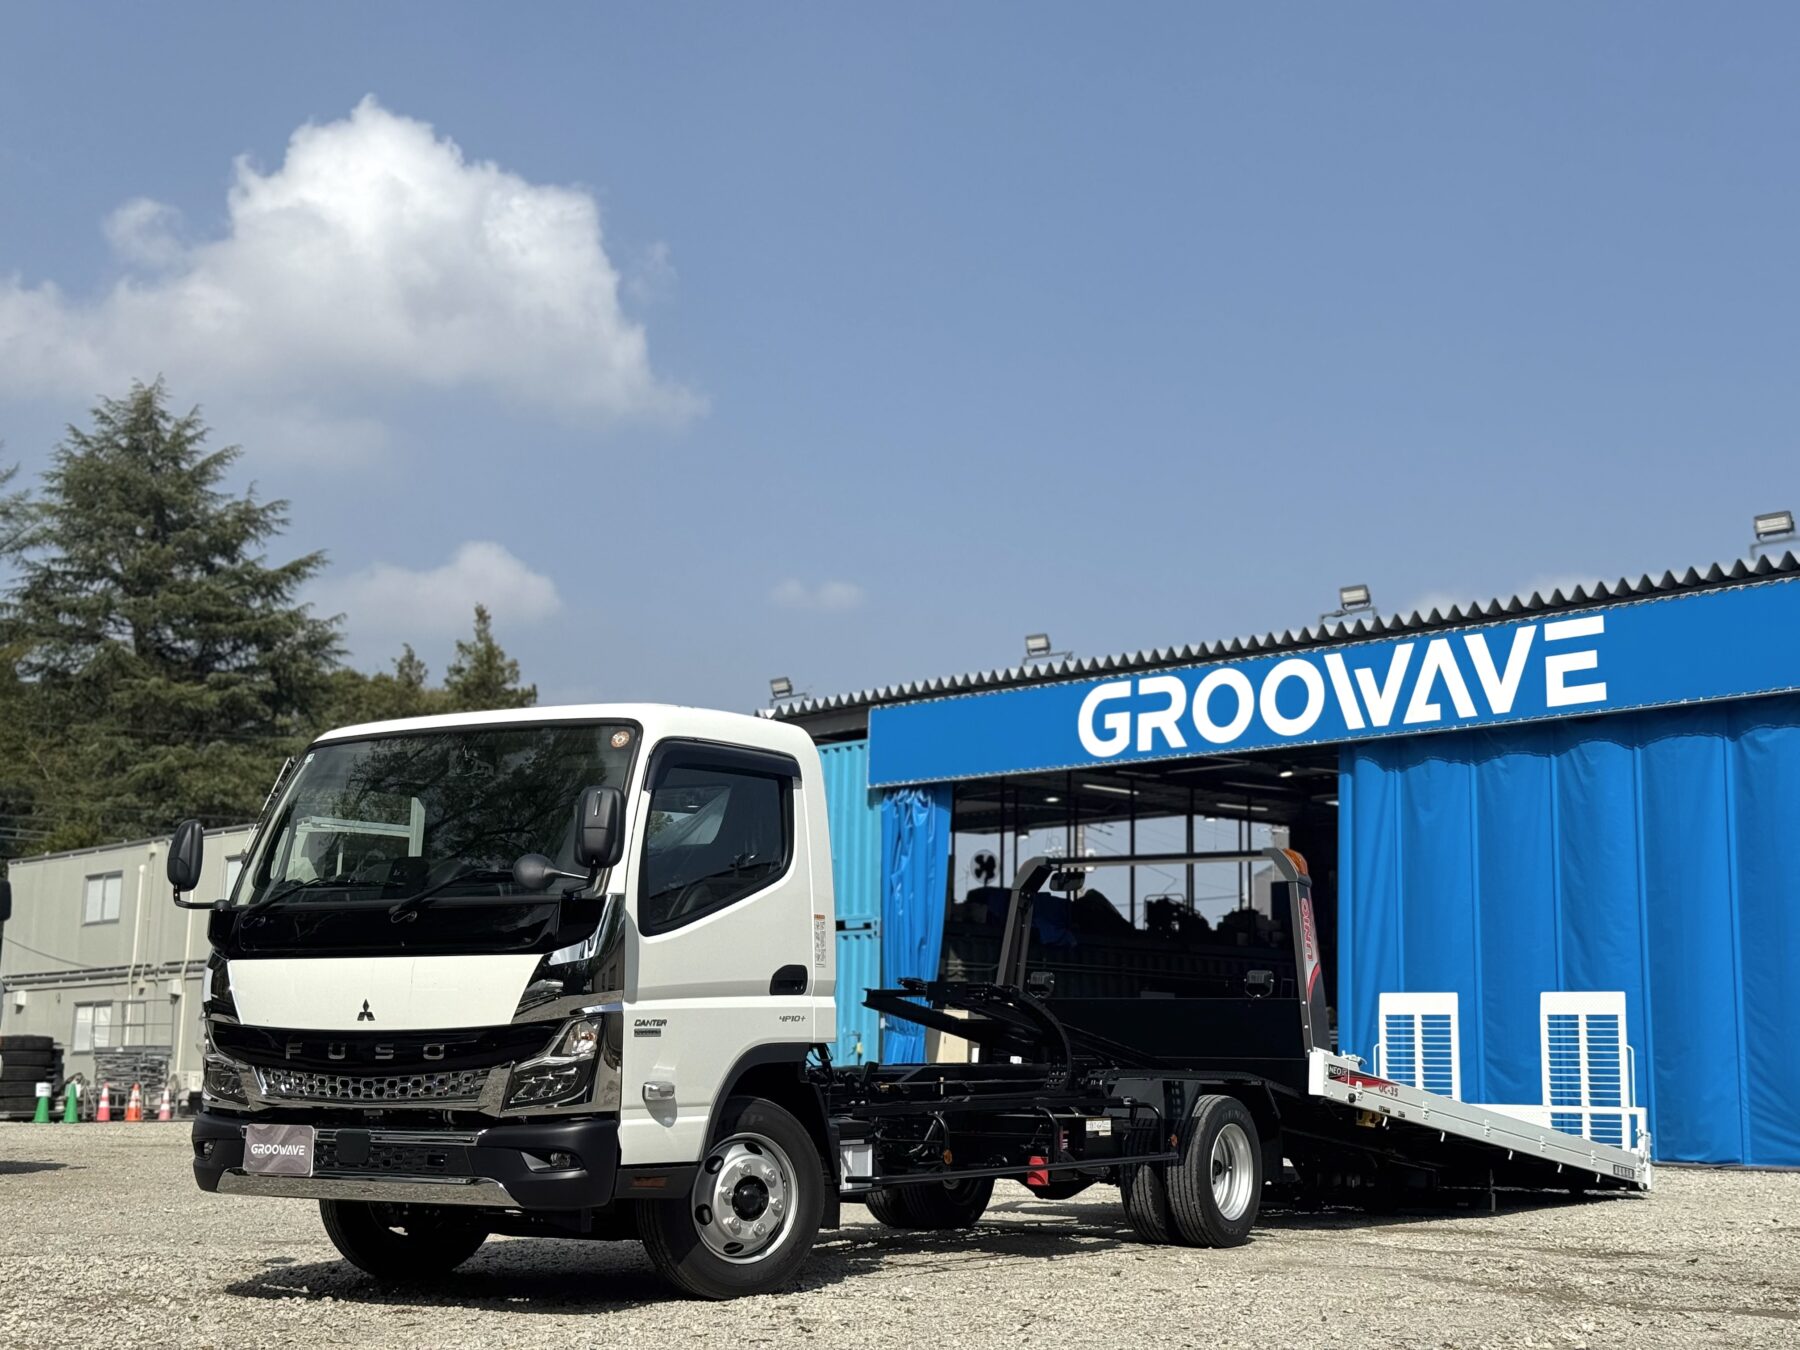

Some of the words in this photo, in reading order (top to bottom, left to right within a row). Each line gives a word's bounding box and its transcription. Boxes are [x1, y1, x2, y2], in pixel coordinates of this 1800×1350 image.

[1077, 614, 1608, 758] GROOWAVE
[634, 1018, 668, 1027] CANTER
[285, 1042, 445, 1060] FUSO
[250, 1143, 306, 1156] GROOWAVE
